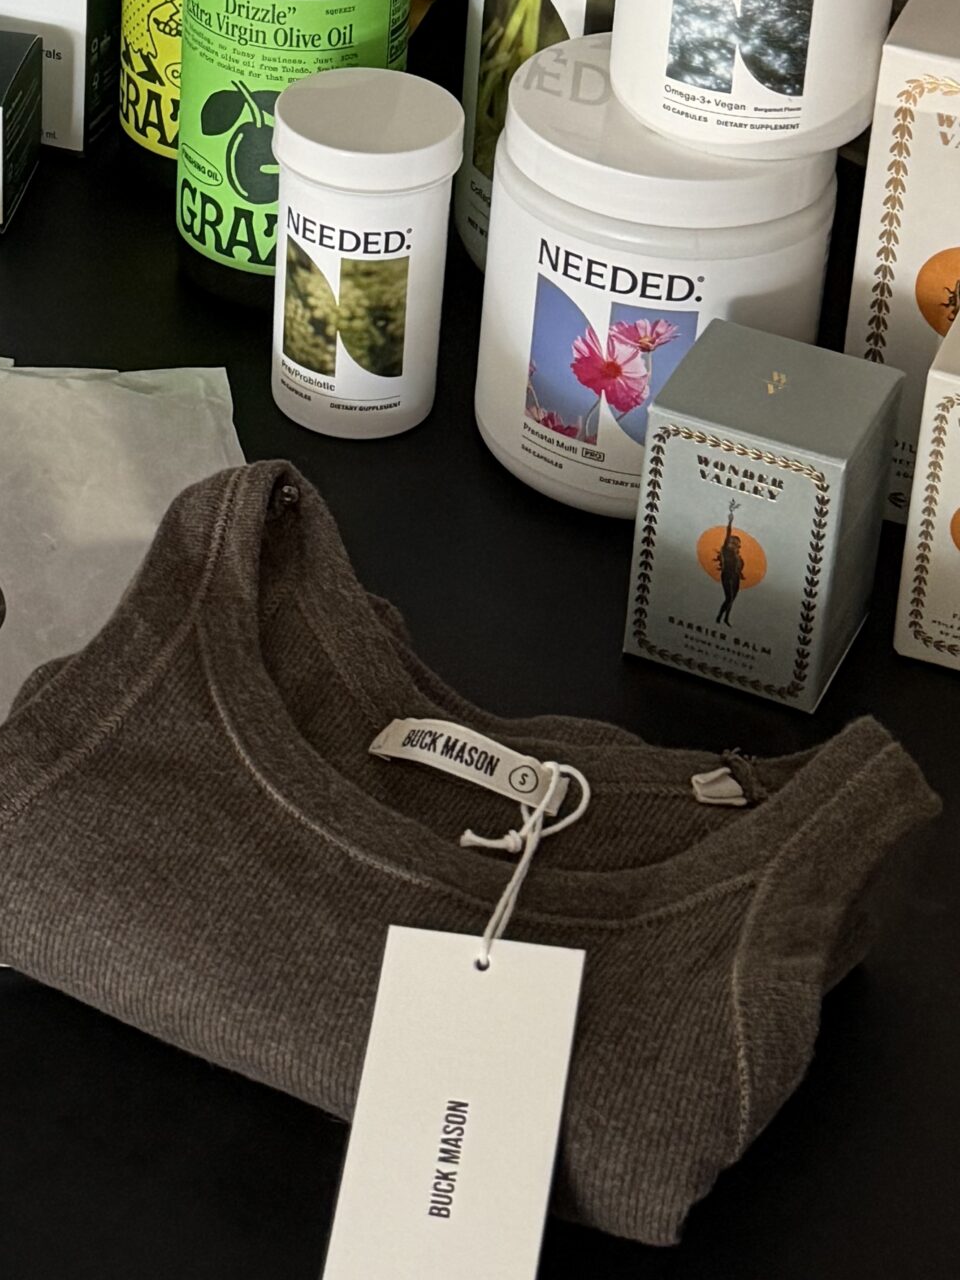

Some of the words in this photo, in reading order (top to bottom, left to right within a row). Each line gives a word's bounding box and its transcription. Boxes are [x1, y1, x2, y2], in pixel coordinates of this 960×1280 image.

[216, 11, 267, 47] Virgin
[273, 26, 322, 48] Olive
[327, 23, 354, 48] Oil
[259, 63, 279, 72] from
[313, 57, 334, 65] Just
[248, 71, 261, 79] for
[266, 74, 284, 82] that
[664, 84, 712, 105] Omega-3+
[714, 98, 746, 111] Vegan
[671, 107, 709, 123] CAPSULES
[716, 119, 749, 129] DIETARY
[749, 122, 800, 131] SUPPLEMENT
[207, 169, 220, 182] OIL
[330, 402, 357, 412] DIETARY
[522, 422, 555, 447] Prenatal
[556, 440, 578, 455] Multi
[697, 454, 784, 490] WONDER
[699, 468, 780, 501] VALLEY
[402, 728, 443, 753] BUCK
[440, 736, 501, 777] MASON
[437, 1099, 470, 1165] MASON
[428, 1168, 458, 1219] BUCK
